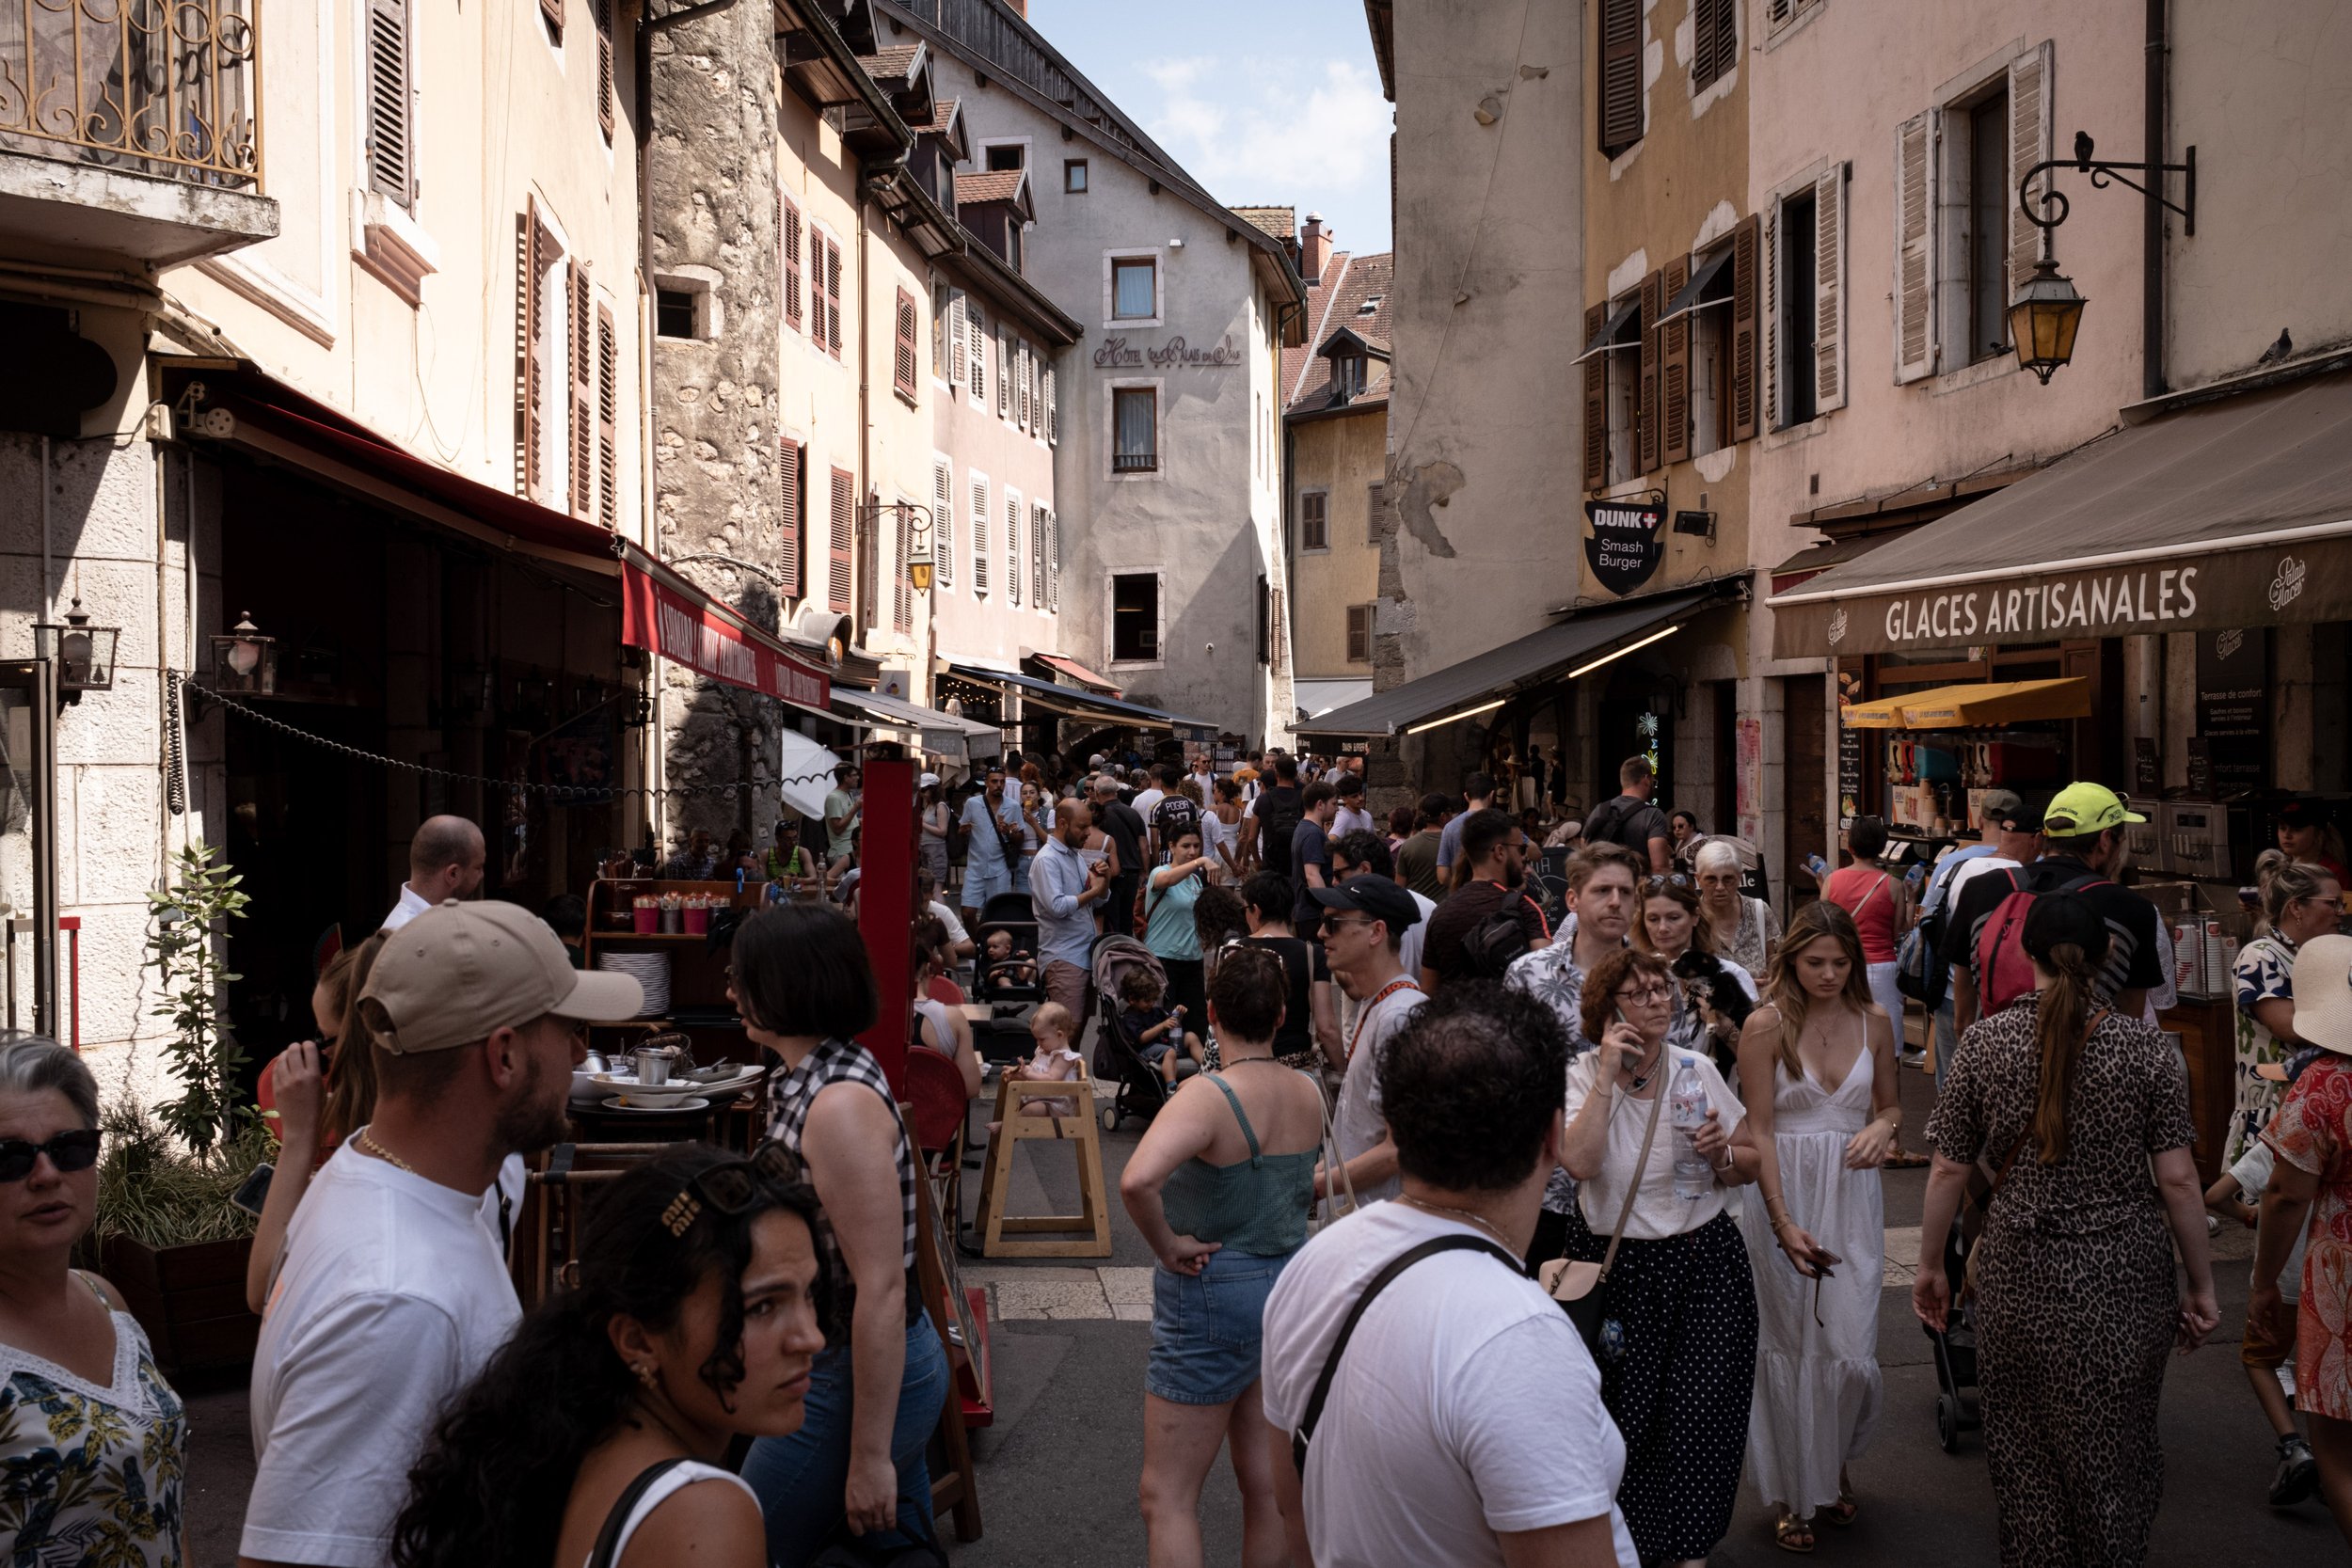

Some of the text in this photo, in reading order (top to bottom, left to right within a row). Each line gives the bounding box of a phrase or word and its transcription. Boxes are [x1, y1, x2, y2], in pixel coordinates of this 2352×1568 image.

[1594, 509, 1643, 529] DUNK
[1601, 538, 1643, 553] Smash
[1599, 553, 1643, 571] Burger
[2278, 555, 2306, 586] Palais
[1885, 566, 2199, 641] GLACES ARTISANALES
[2269, 578, 2304, 611] Glaces
[2201, 688, 2263, 701] Terrasse de confort
[2213, 762, 2233, 774] mfort
[1166, 800, 1189, 812] POGBA
